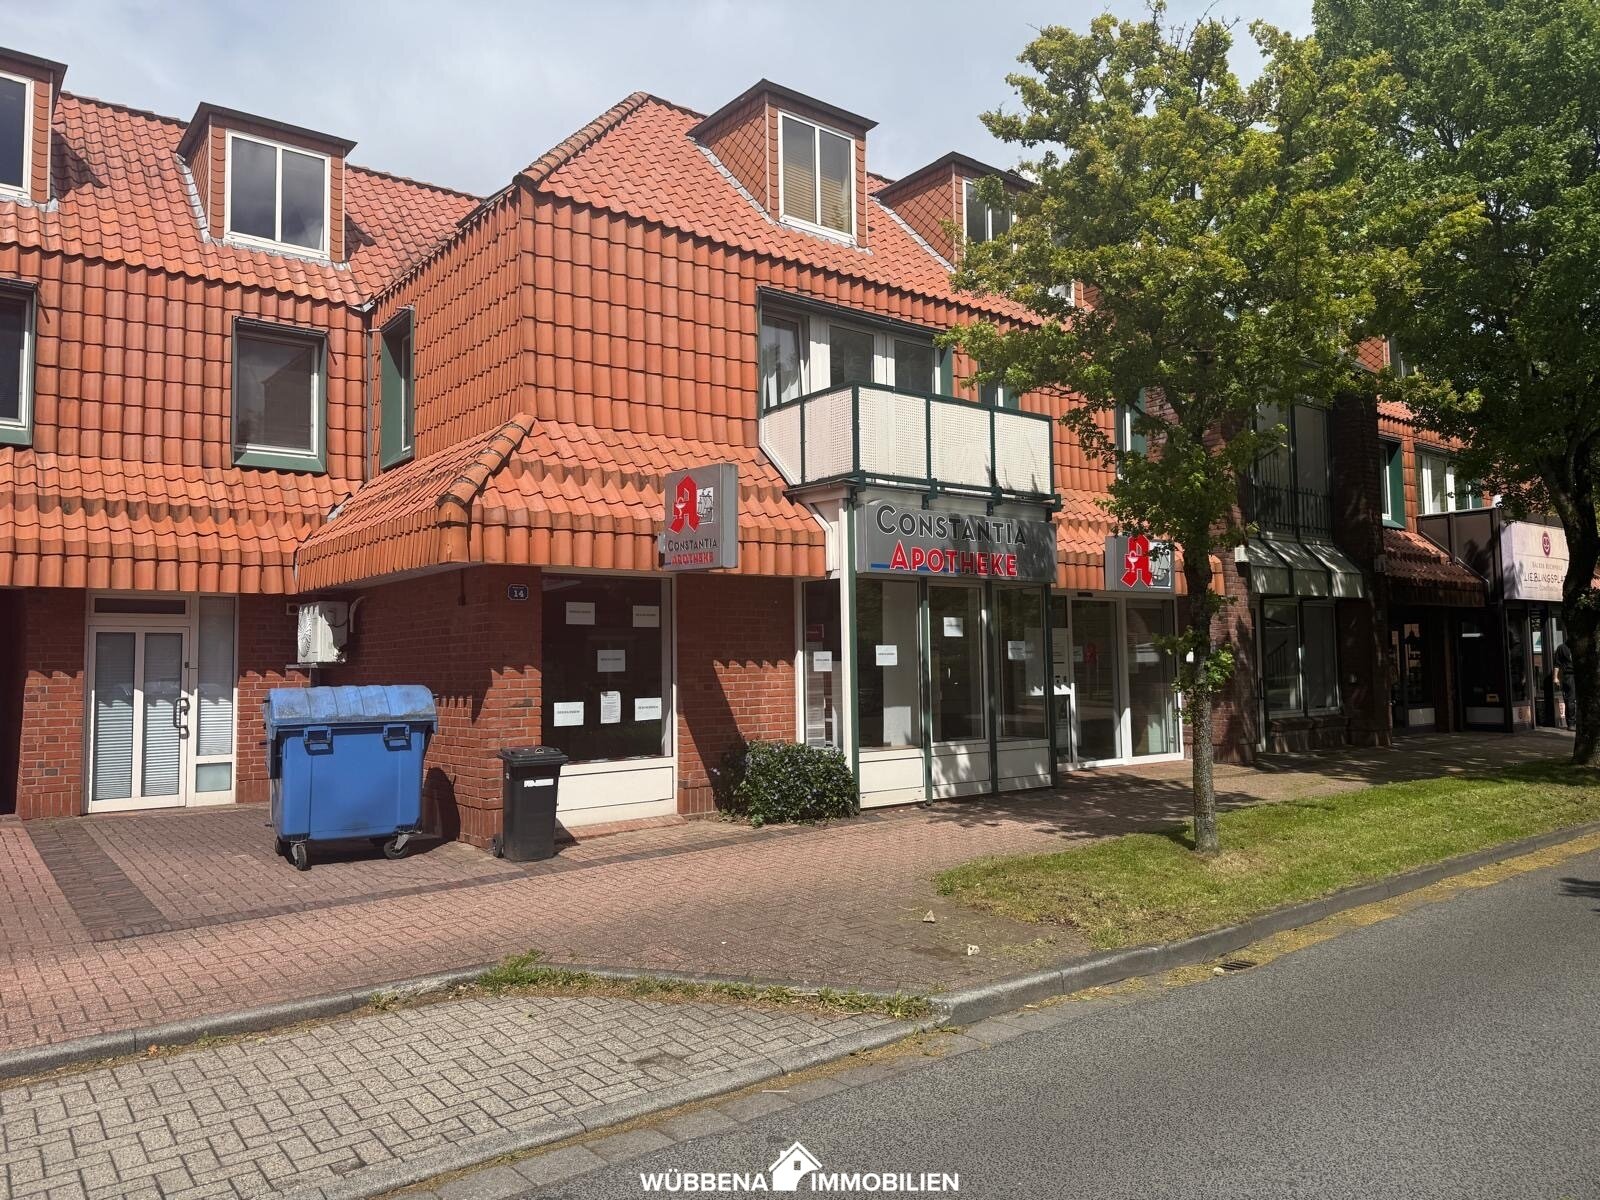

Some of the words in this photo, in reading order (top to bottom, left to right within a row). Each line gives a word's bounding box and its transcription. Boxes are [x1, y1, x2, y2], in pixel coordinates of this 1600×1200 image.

[876, 504, 1027, 545] CONSTANTIA
[667, 538, 717, 551] CONSTANTIA
[671, 551, 714, 566] APOTHEKE
[889, 539, 1018, 577] APOTHEKE
